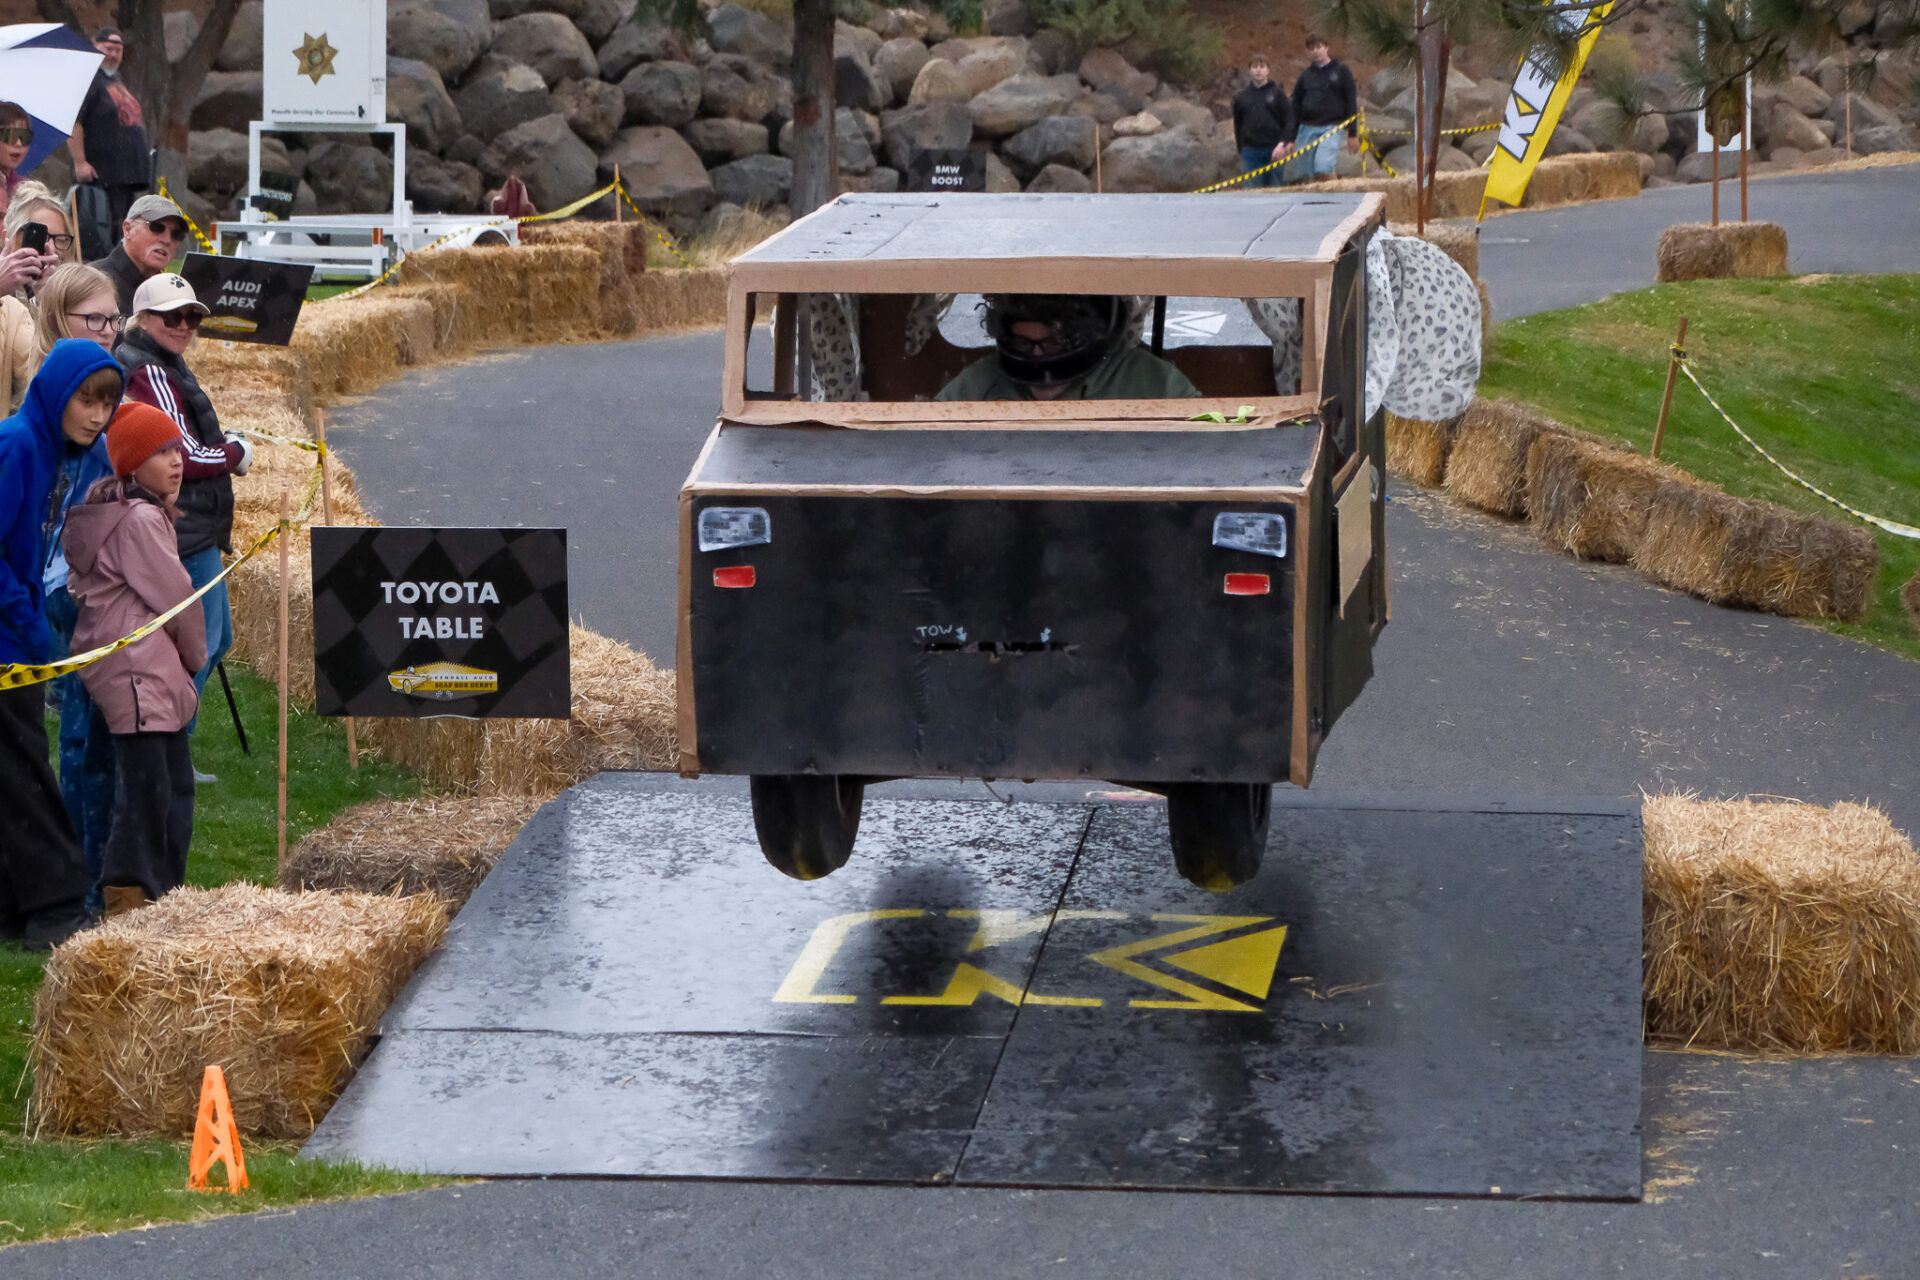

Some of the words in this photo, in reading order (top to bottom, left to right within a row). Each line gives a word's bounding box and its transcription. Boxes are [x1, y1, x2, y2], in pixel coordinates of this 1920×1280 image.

[935, 165, 960, 174] BMW
[931, 176, 963, 185] BOOST
[222, 280, 262, 293] AUDI
[216, 295, 257, 309] APEX
[380, 581, 500, 604] TOYOTA
[398, 617, 483, 639] TABLE
[915, 624, 953, 637] TOW
